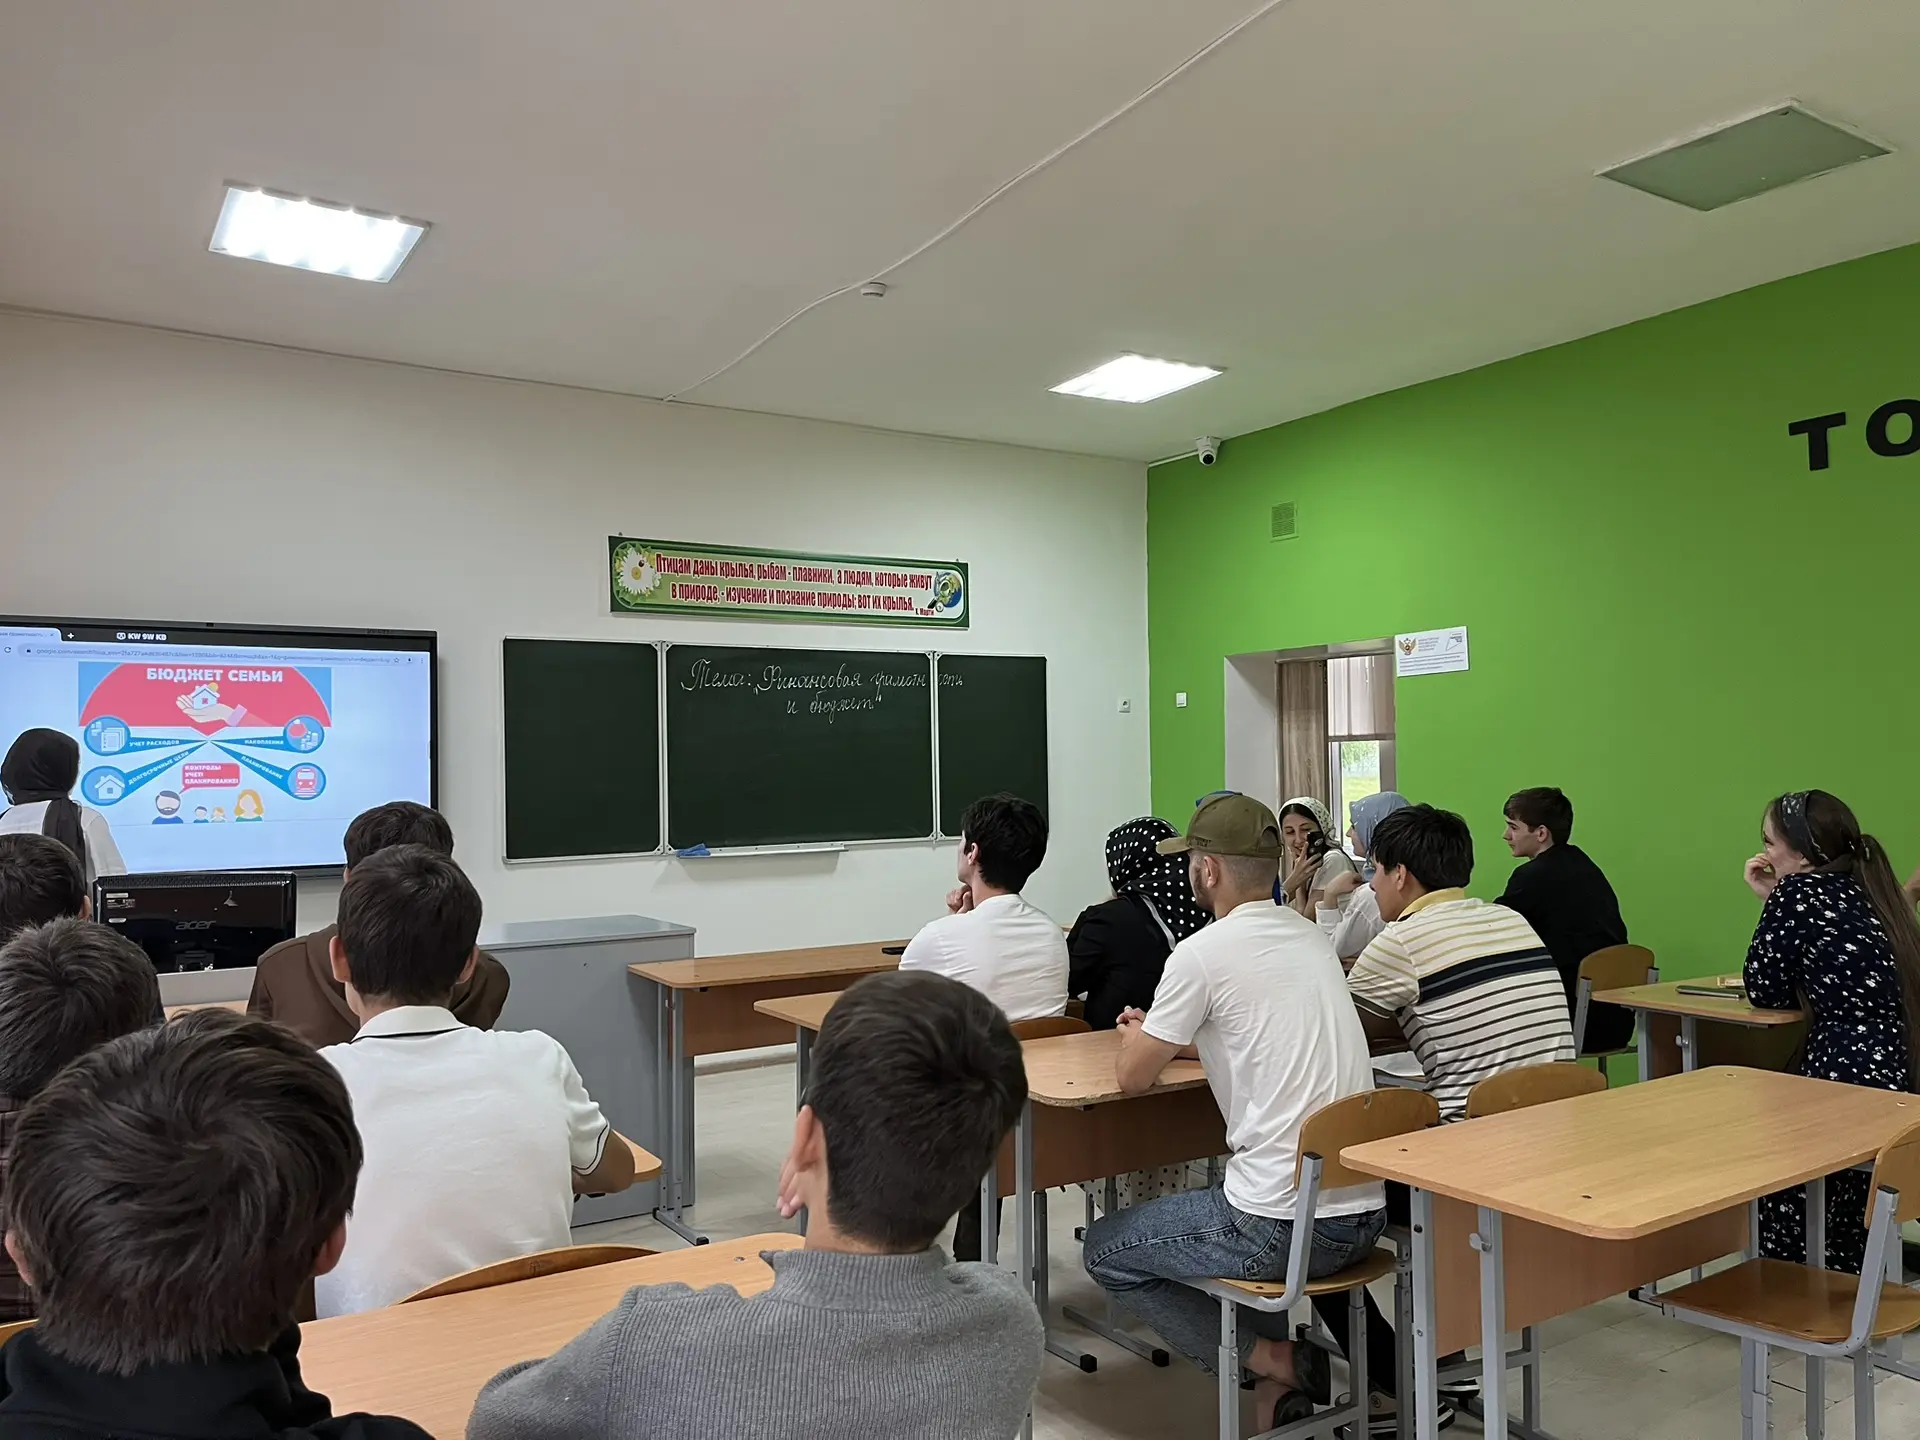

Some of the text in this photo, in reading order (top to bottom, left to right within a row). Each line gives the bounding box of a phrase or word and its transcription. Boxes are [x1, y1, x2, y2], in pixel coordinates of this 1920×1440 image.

[655, 554, 691, 576] Птицам
[693, 559, 718, 577] даны
[719, 561, 756, 579] крылья,
[757, 562, 787, 580] рыбам
[792, 566, 835, 585] плавники,
[837, 570, 842, 583] а
[843, 570, 873, 588] людям,
[875, 571, 908, 589] которые
[909, 574, 933, 591] живут
[671, 583, 677, 599] в
[679, 584, 719, 603] природе,
[726, 586, 767, 604] изучение
[768, 588, 774, 604] и
[776, 589, 816, 607] познание
[818, 592, 857, 610] природы;
[858, 594, 871, 609] вот
[872, 595, 882, 610] их
[883, 596, 914, 612] крылья.
[147, 668, 283, 683] БЮДЖЕТ СЕМЬИ
[680, 658, 751, 691] Тема:
[786, 700, 799, 714] и
[241, 755, 283, 779] ПЛАНИРОВАНИЕ
[175, 921, 217, 930] acer
